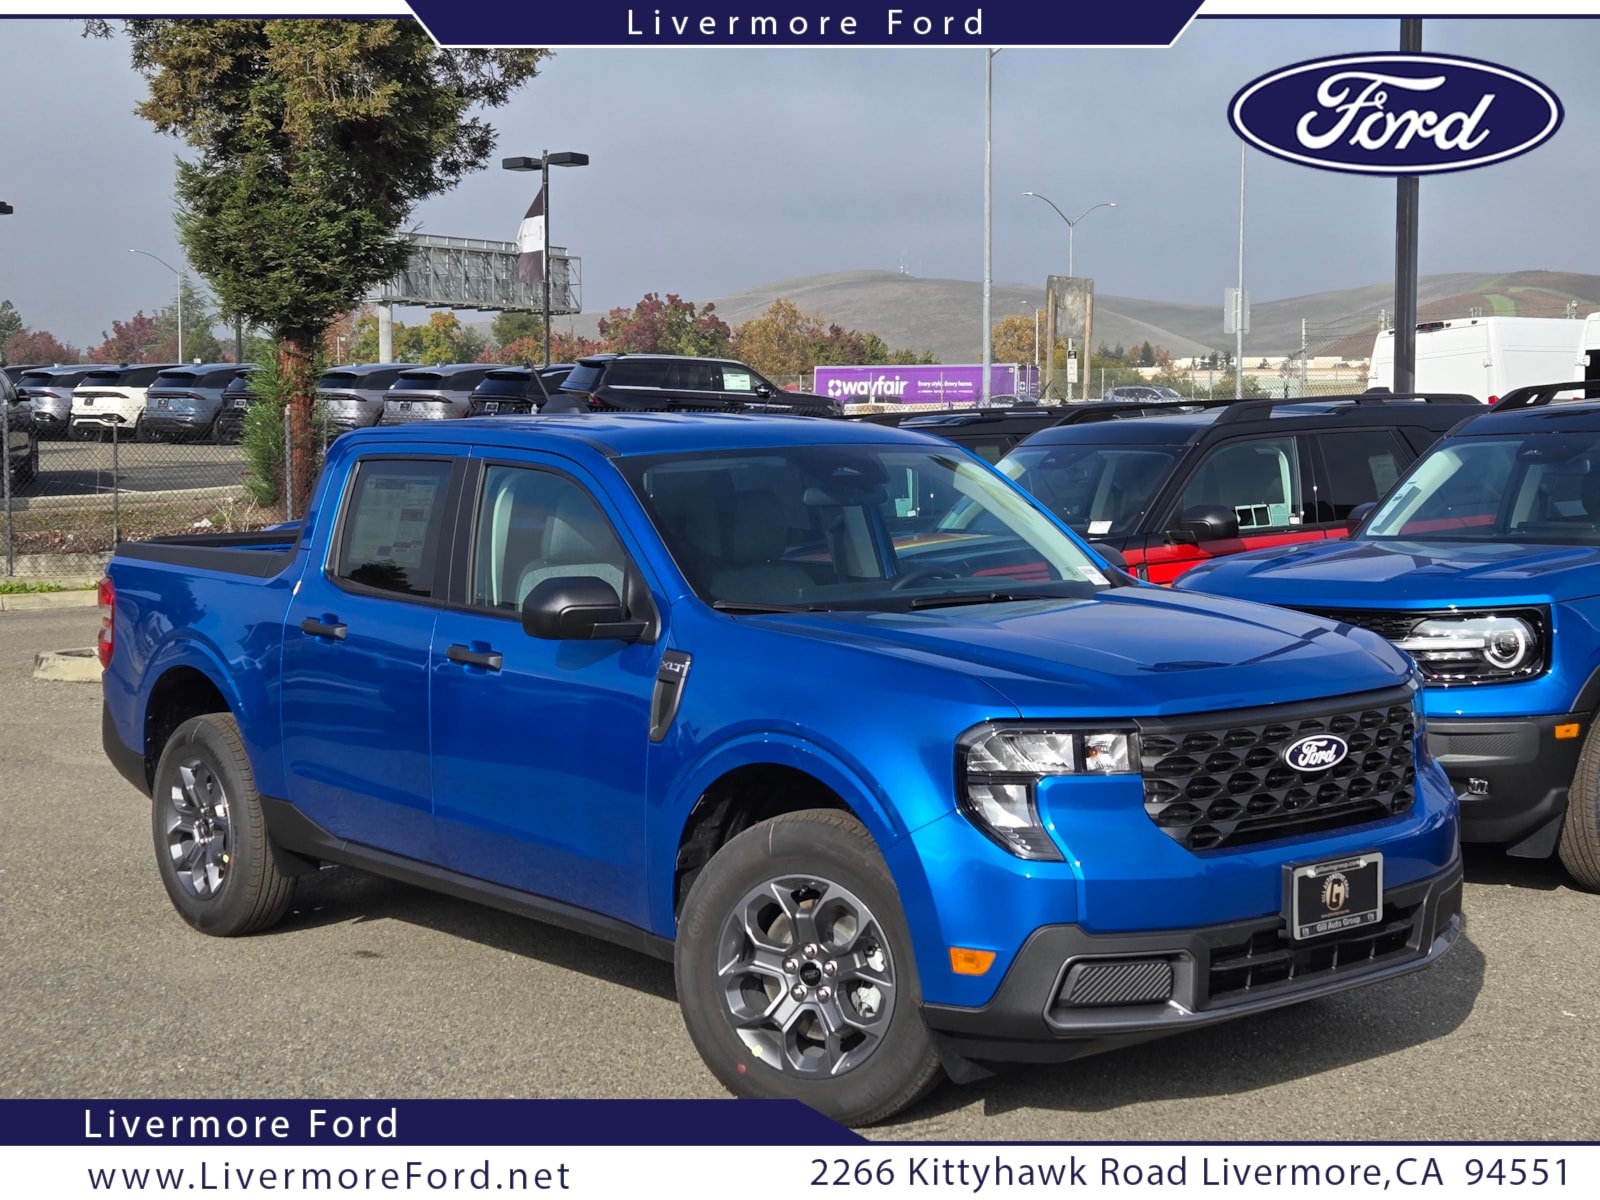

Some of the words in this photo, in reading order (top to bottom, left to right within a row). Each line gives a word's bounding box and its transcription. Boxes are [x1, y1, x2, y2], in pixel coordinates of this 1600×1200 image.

[842, 375, 909, 396] wayfair
[660, 660, 685, 673] XLT
[1298, 740, 1338, 767] Ford
[1328, 920, 1342, 930] Auto
[1342, 916, 1361, 927] Group
